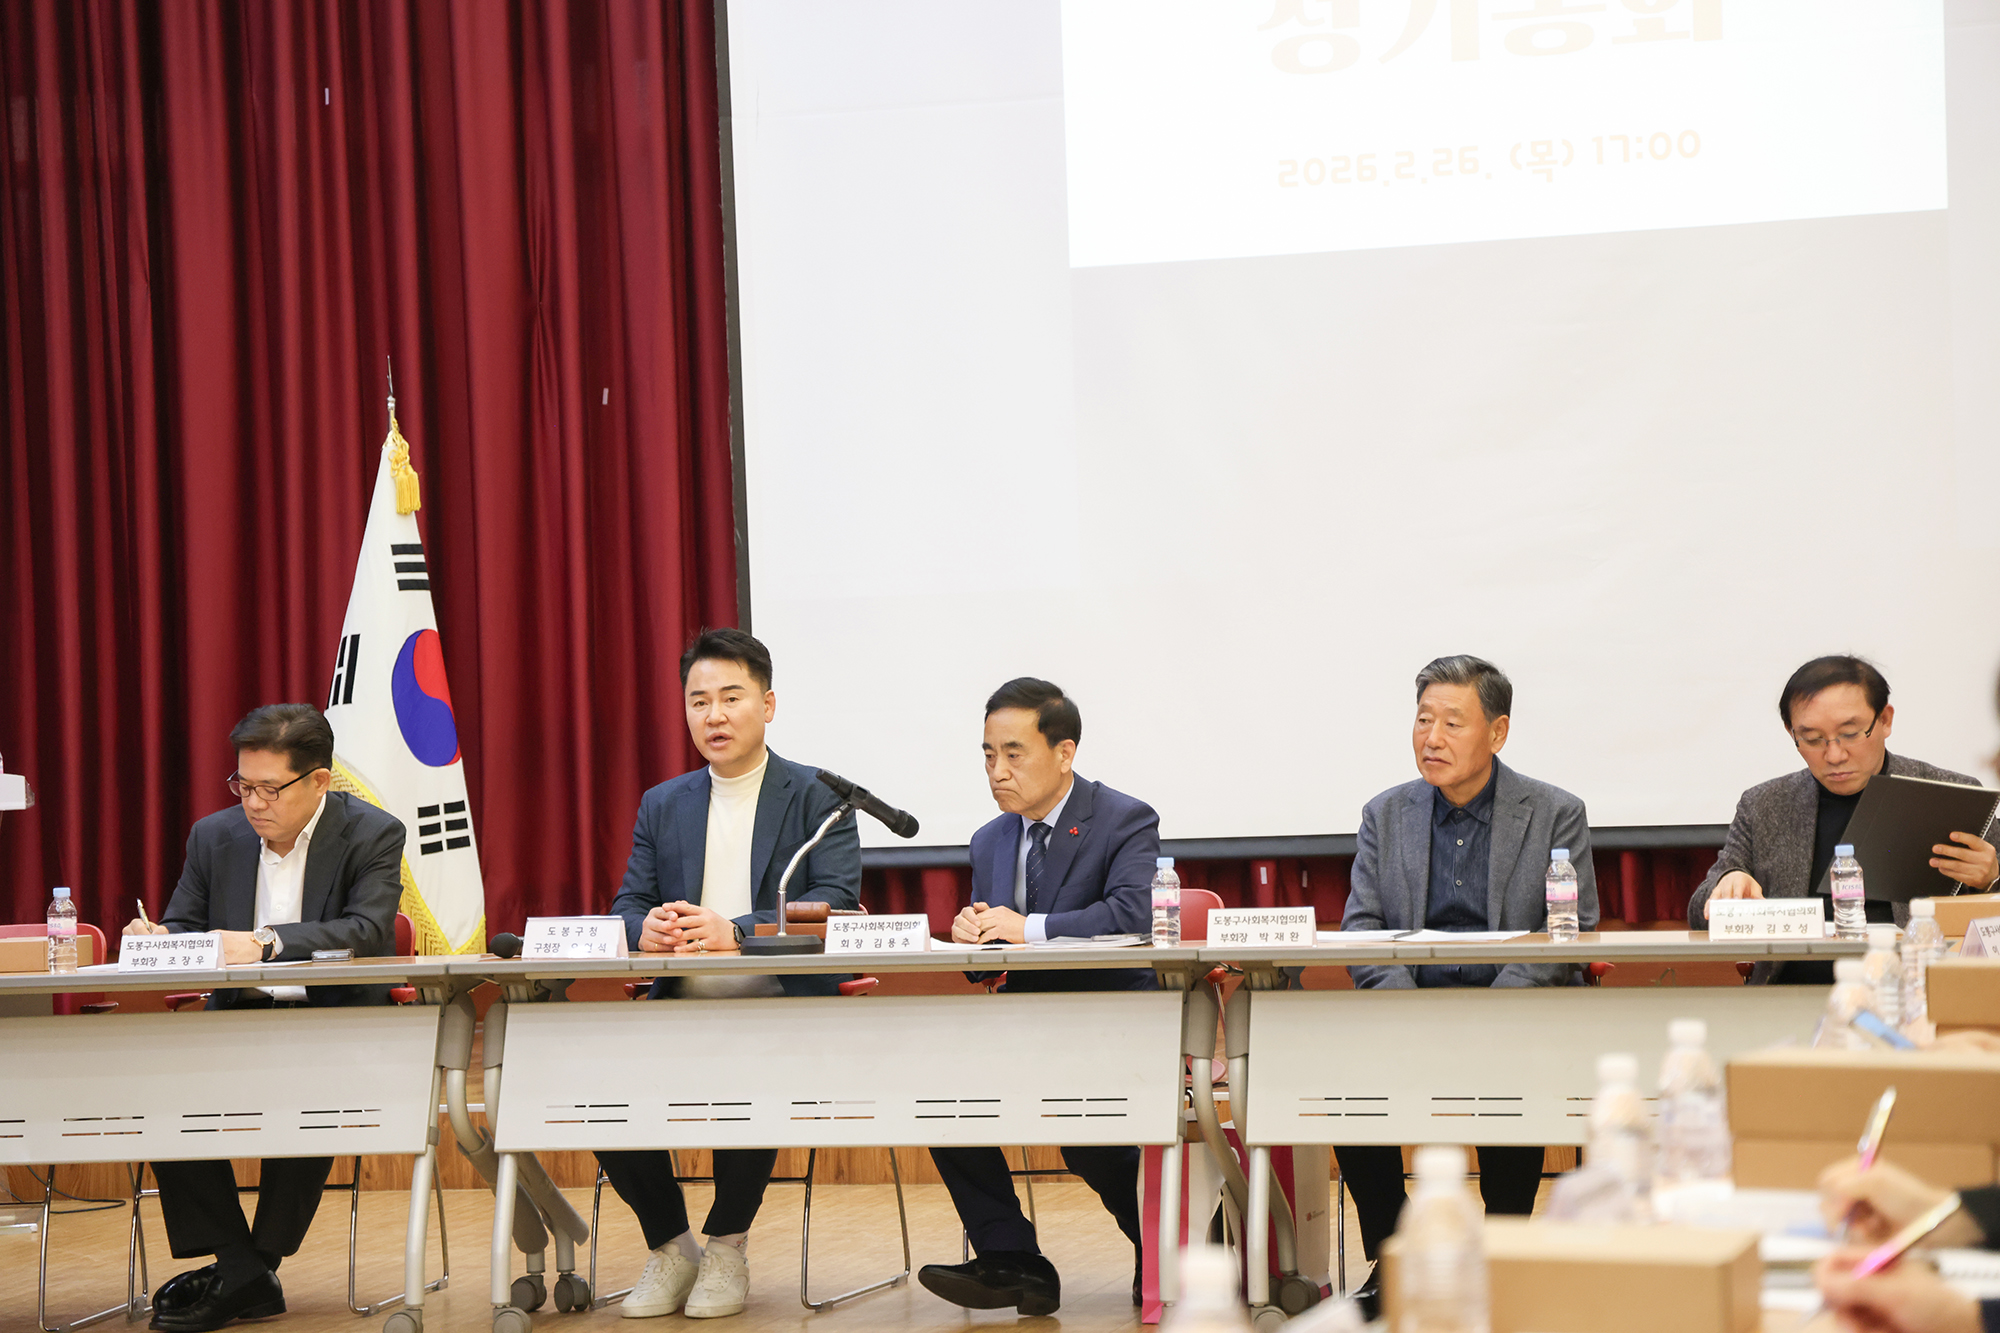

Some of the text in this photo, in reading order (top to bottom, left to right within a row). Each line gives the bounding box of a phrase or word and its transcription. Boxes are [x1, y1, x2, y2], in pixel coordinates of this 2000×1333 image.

[1509, 138, 1575, 183] (목)
[1590, 129, 1702, 165] 17:00
[1214, 914, 1308, 926] 도봉구사회복지협의회
[1724, 924, 1754, 934] 부회장
[1220, 932, 1248, 943] 부회장
[126, 939, 214, 951] 도봉구사회복지협의회
[534, 942, 561, 953] 구청장
[131, 957, 158, 967] 부회장
